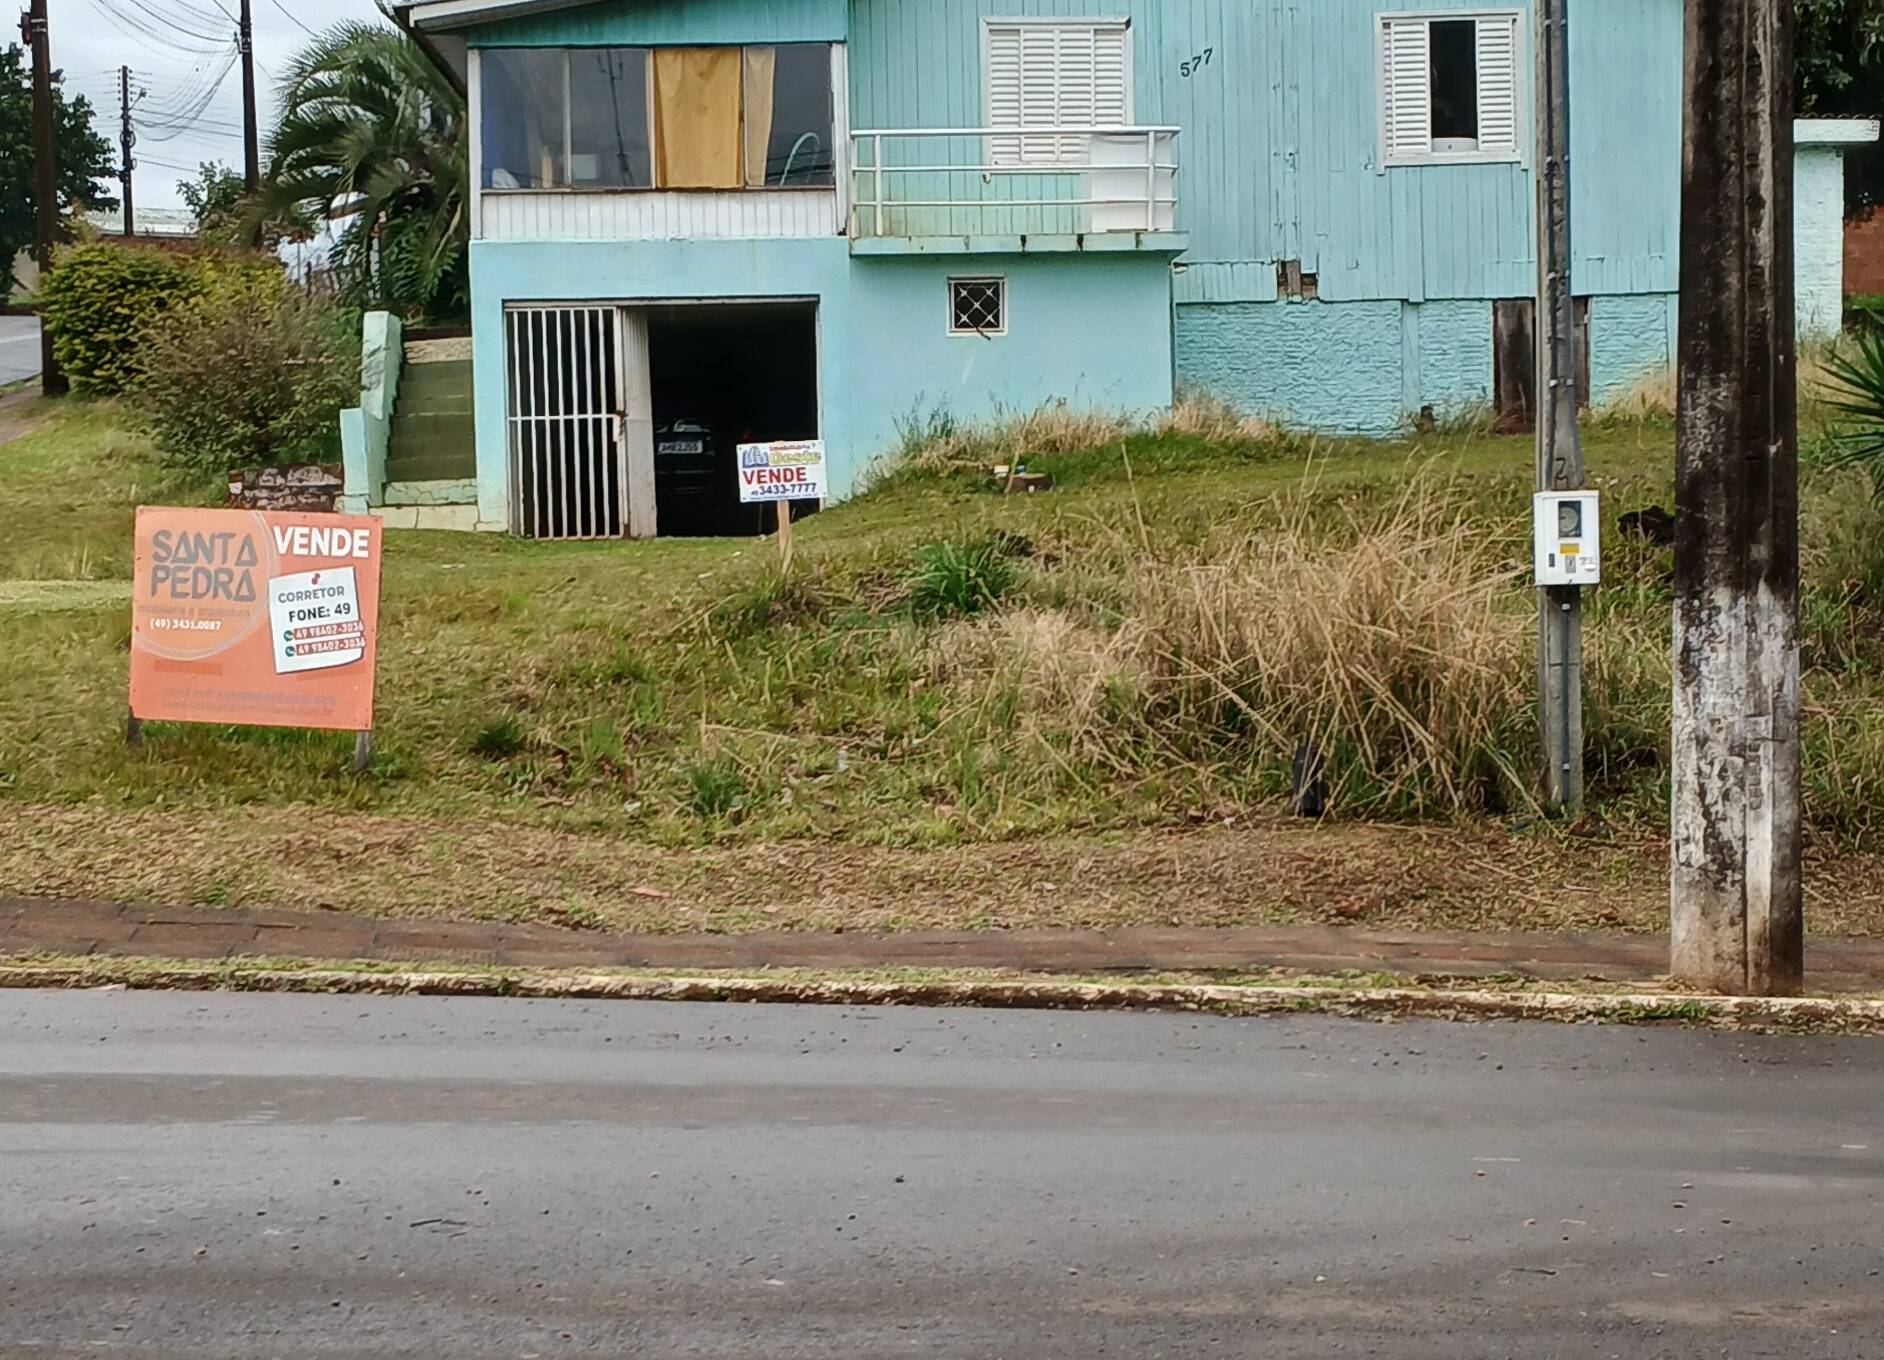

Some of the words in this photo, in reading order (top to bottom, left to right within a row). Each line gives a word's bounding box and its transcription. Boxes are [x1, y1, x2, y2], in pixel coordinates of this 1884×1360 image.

[1180, 46, 1213, 77] 577
[742, 467, 807, 485] VENDE
[759, 482, 817, 495] 3433-7777
[152, 530, 258, 567] SANTA
[272, 525, 370, 558] VENDE
[151, 565, 257, 602] PEDRA
[278, 586, 345, 604] CORRETOR
[288, 605, 331, 623] FONE:
[334, 603, 351, 616] 49
